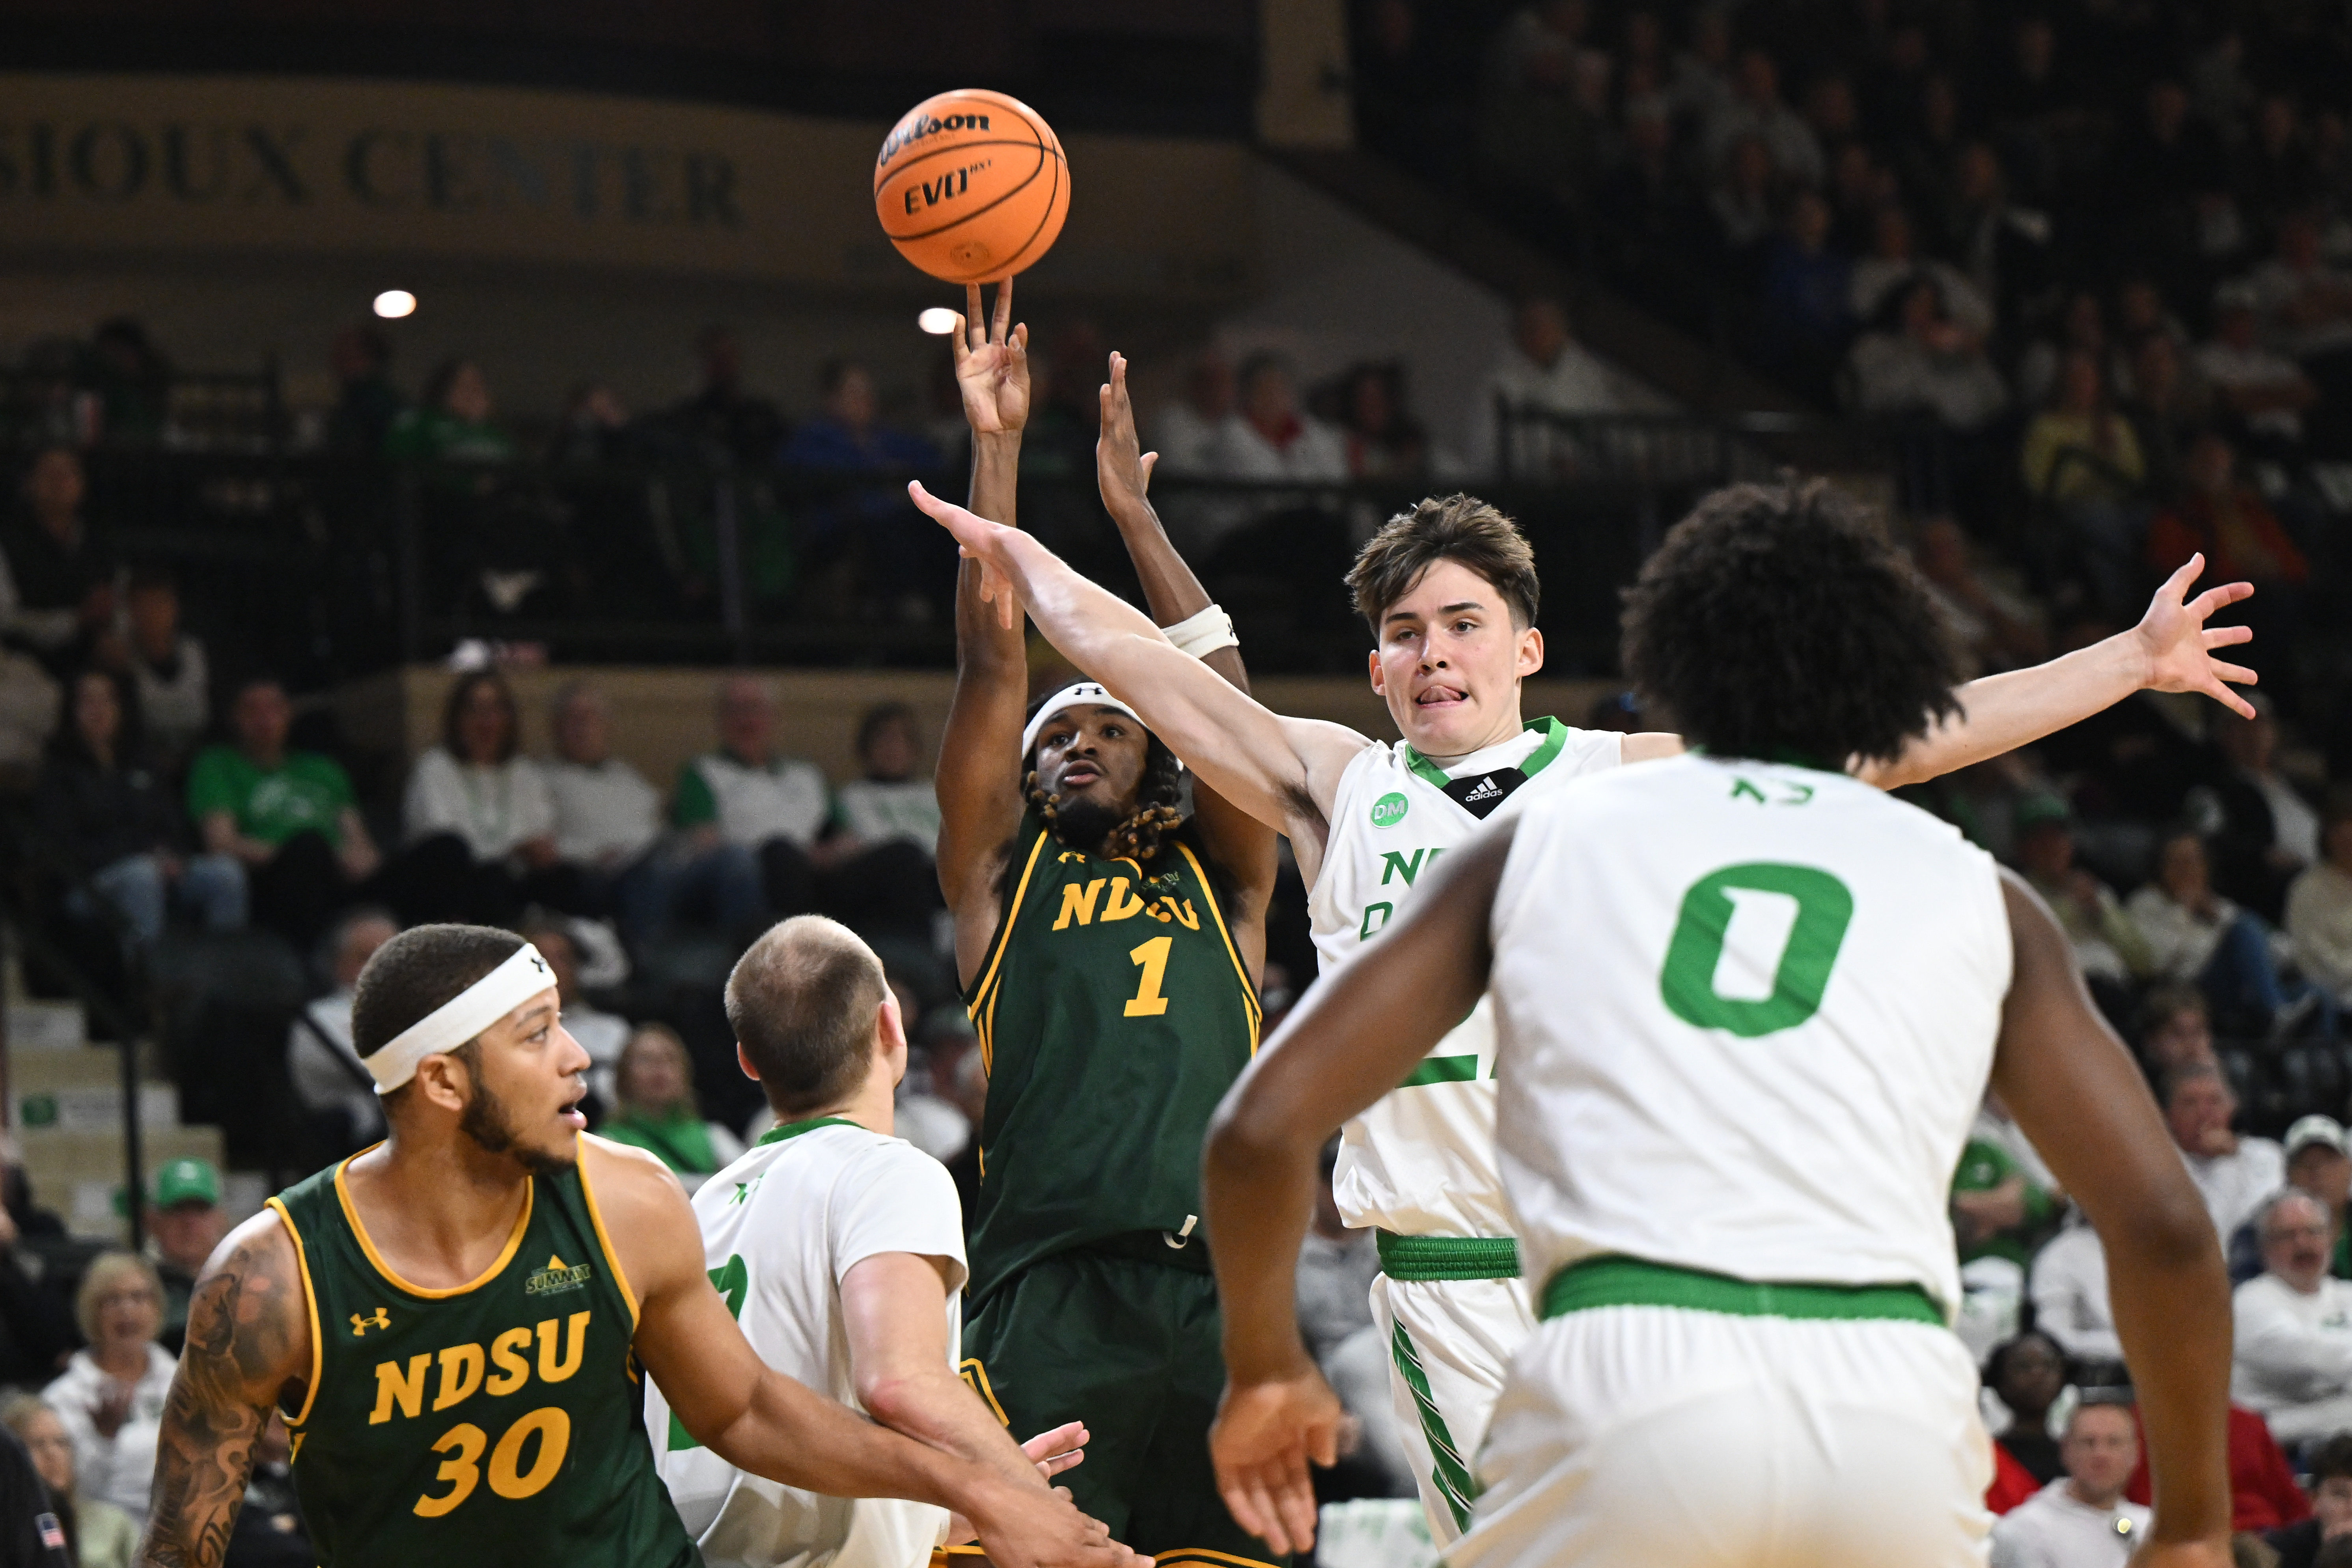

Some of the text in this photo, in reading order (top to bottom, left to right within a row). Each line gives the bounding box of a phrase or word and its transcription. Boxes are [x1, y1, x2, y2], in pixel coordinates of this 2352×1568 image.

[341, 121, 748, 233] CENTER
[880, 114, 990, 167] Wilson
[1375, 800, 1405, 820] DM
[1465, 789, 1503, 802] adidas
[1123, 936, 1172, 1017] 1
[1660, 860, 1853, 1038] 0
[369, 1311, 591, 1424] NDSU
[413, 1407, 571, 1517] 30
